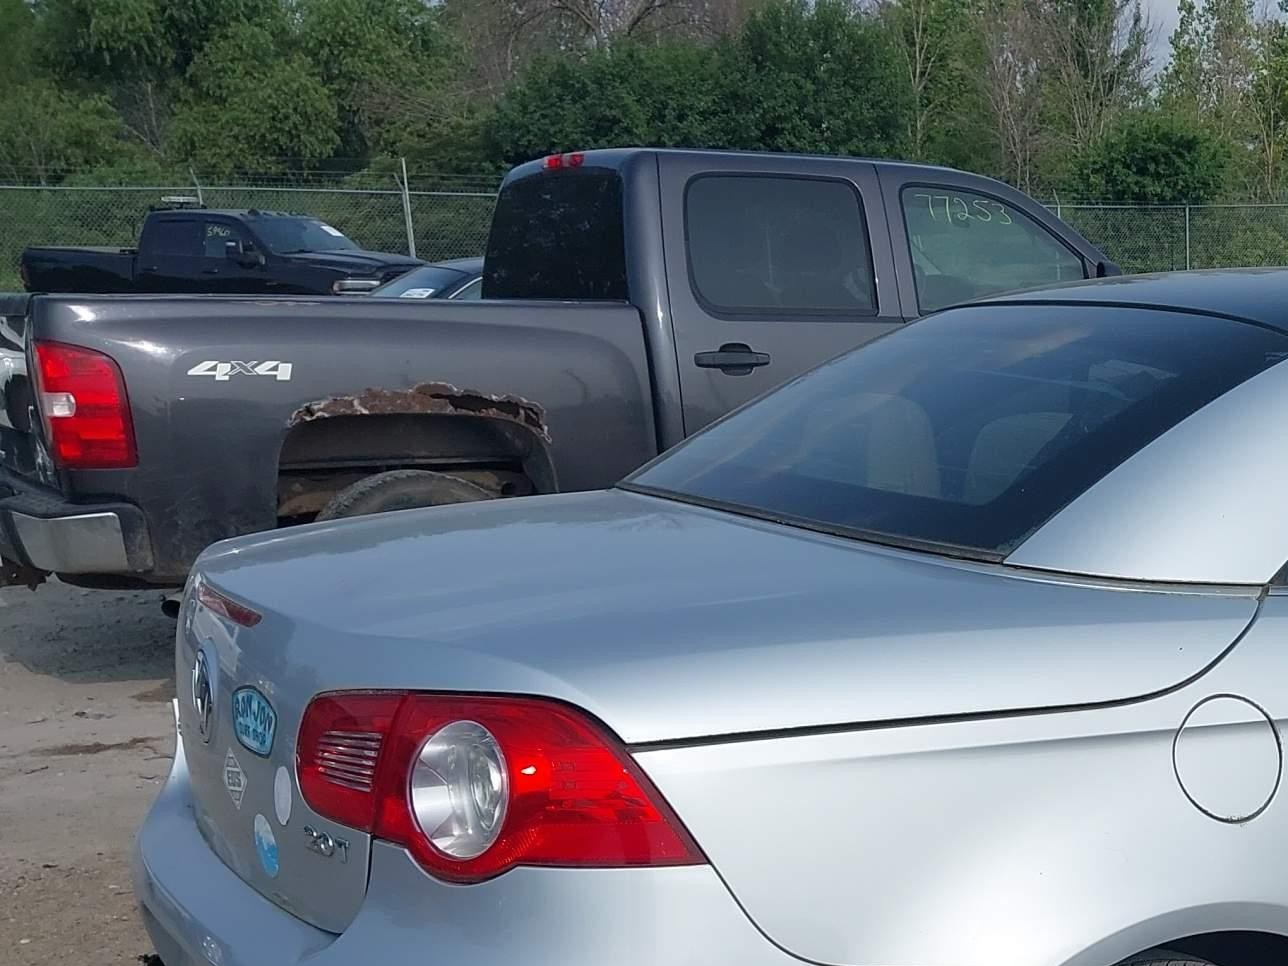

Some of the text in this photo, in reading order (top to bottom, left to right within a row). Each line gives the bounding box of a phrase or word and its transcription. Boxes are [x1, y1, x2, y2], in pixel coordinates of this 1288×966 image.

[914, 194, 1013, 225] 77253
[234, 694, 274, 735] RON JON
